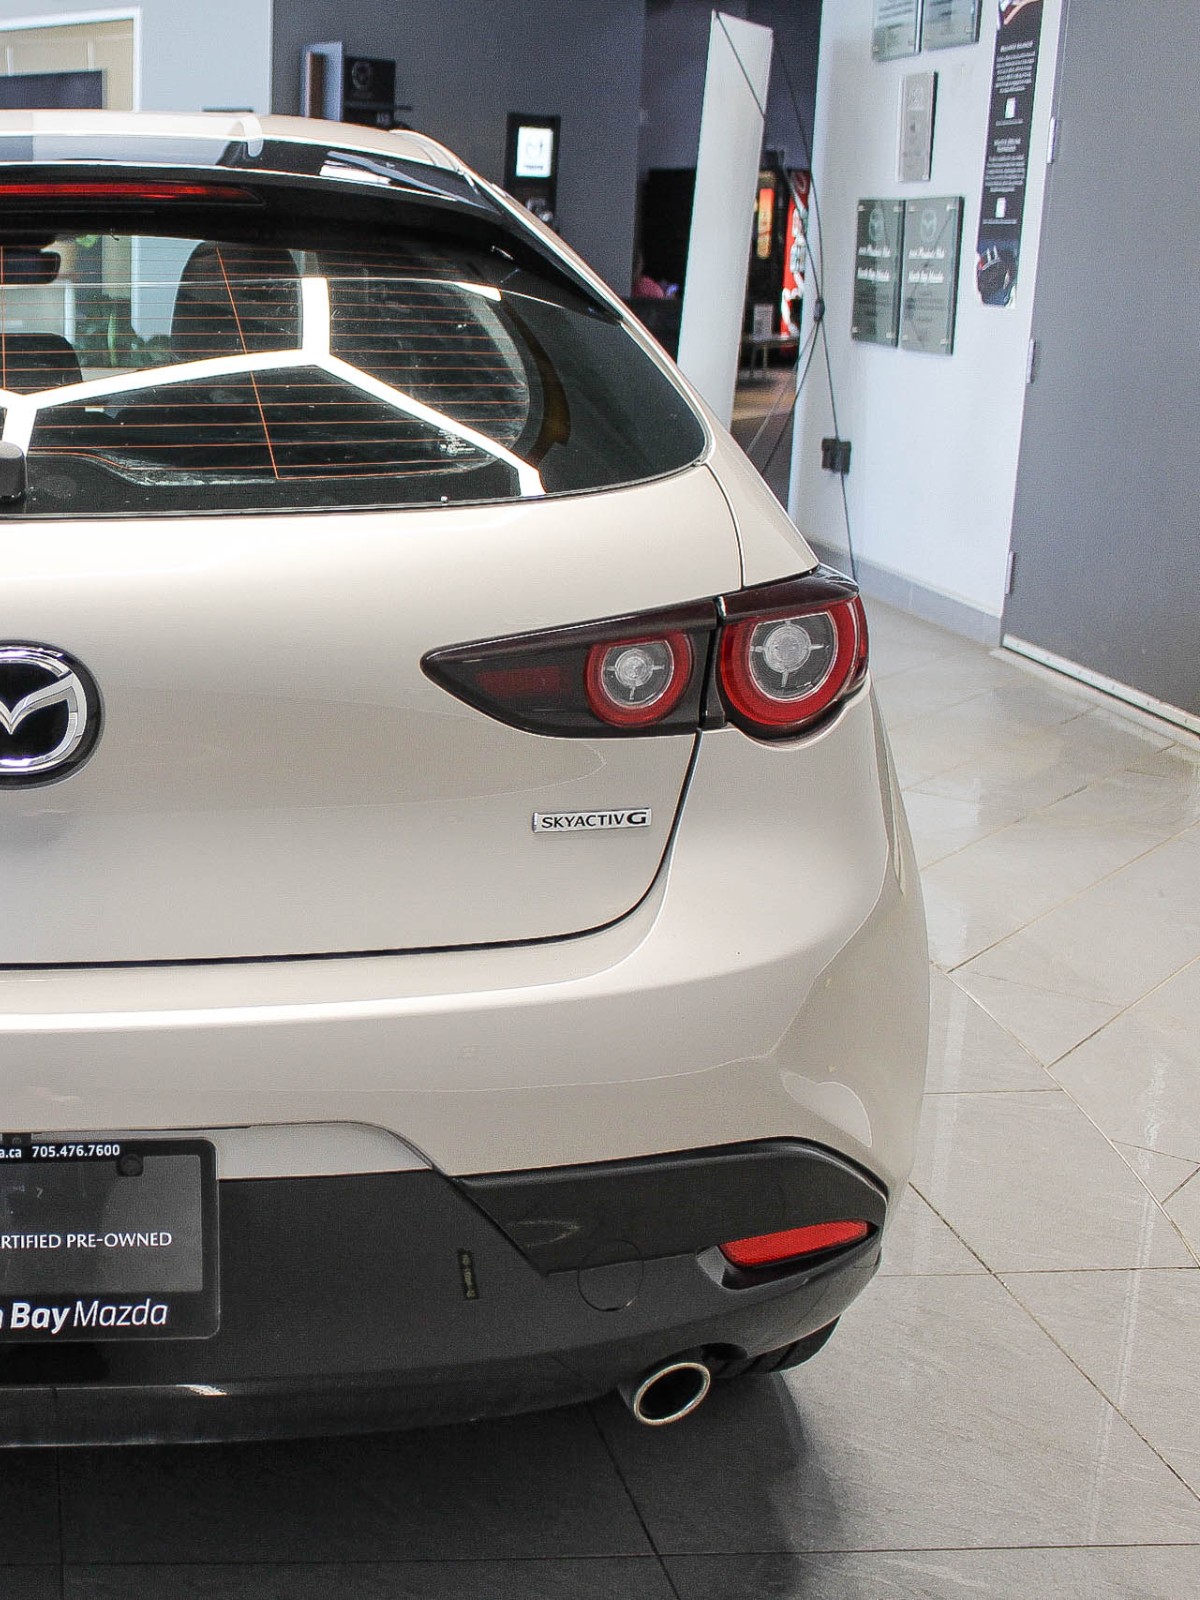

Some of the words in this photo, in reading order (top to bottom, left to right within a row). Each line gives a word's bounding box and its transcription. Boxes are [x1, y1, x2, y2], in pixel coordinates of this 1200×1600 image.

[32, 1144, 120, 1158] 705.476.7600
[66, 1232, 173, 1249] PRE-OWNED
[10, 1302, 71, 1335] Bay
[73, 1298, 169, 1328] Mazda
